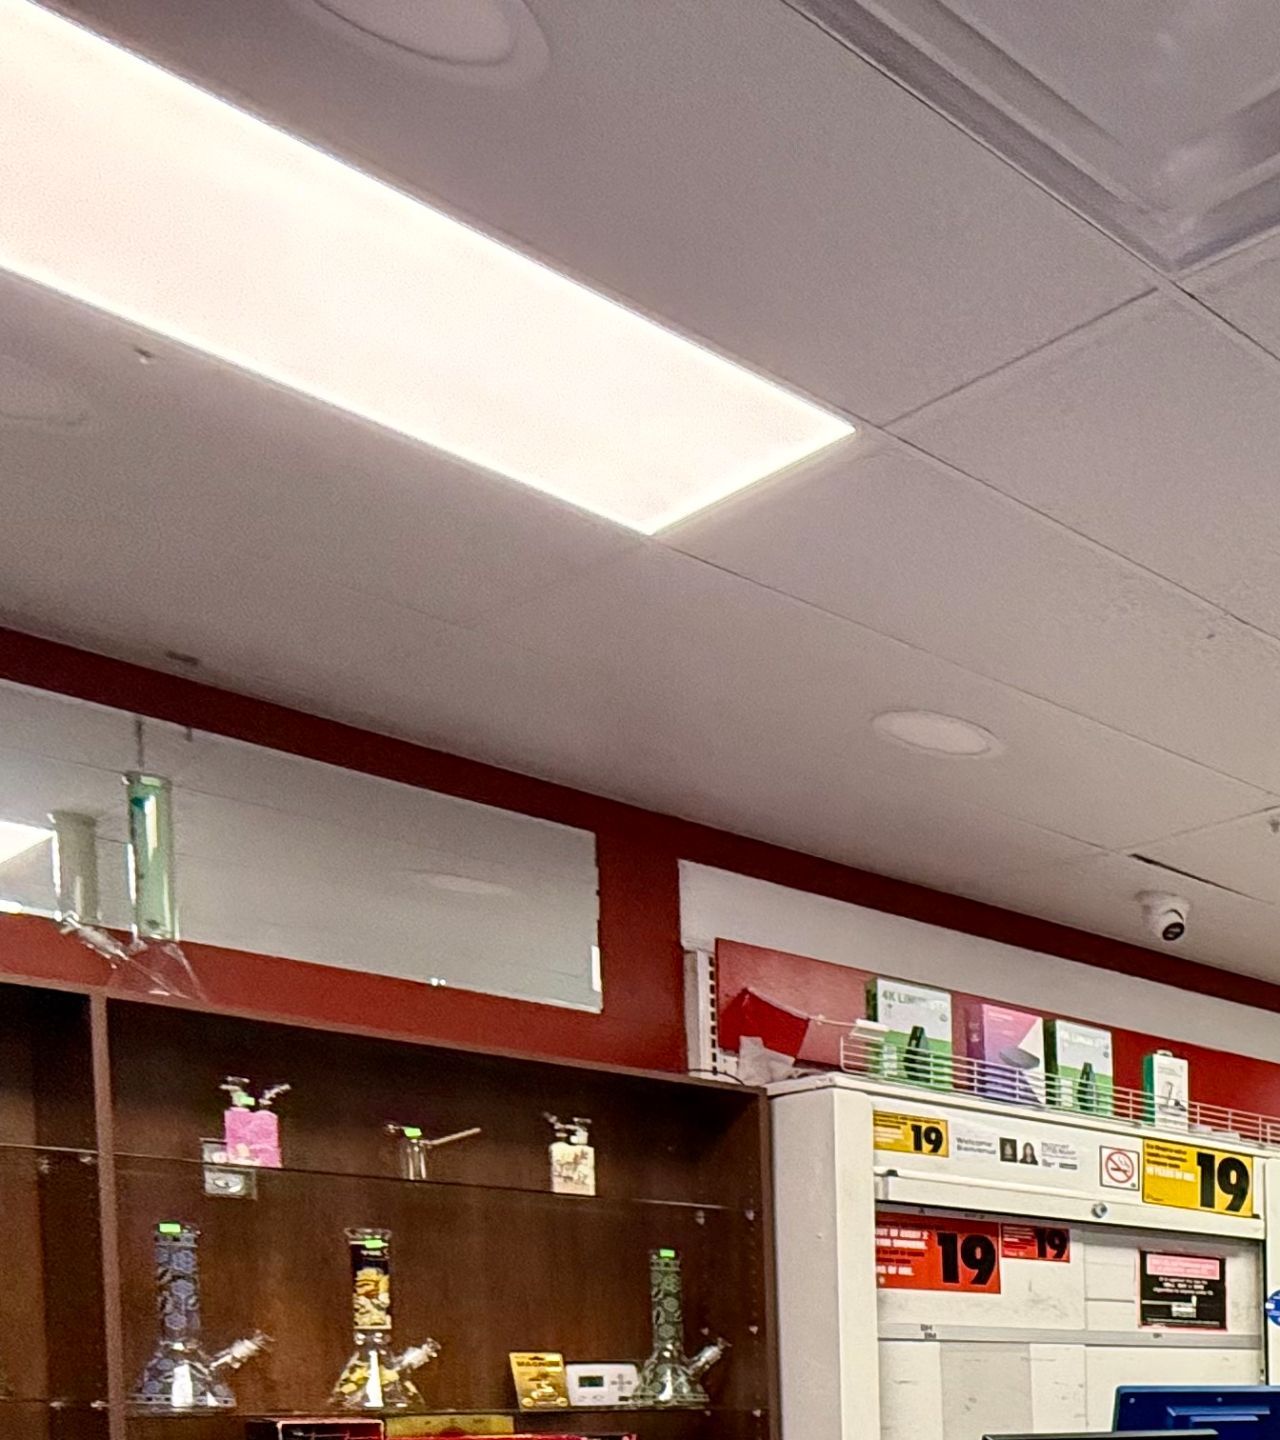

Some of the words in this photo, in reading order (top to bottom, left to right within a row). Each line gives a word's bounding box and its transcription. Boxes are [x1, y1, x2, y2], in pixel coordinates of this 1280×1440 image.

[910, 1124, 944, 1154] 19
[1197, 1151, 1250, 1212] 19
[937, 1231, 997, 1285] 19
[1033, 1227, 1069, 1259] 19
